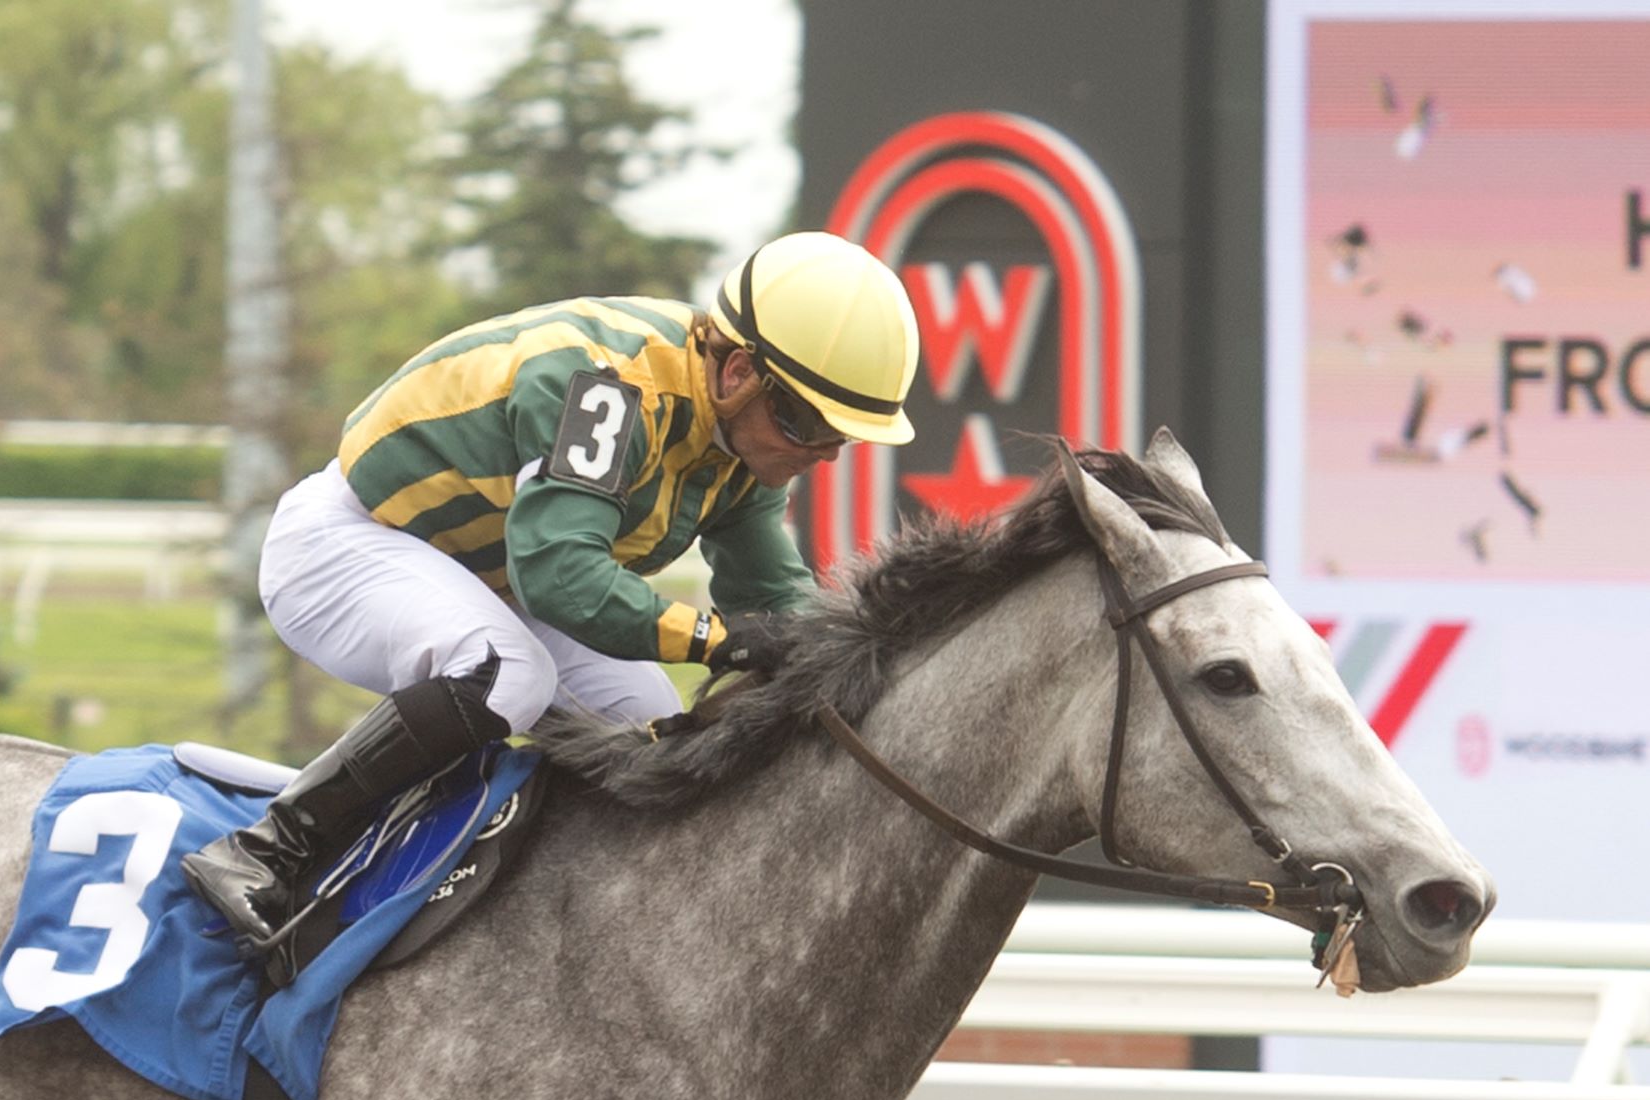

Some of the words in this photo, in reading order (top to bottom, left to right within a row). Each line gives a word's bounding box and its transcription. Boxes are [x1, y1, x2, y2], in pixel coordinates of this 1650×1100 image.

[901, 262, 1049, 402] W
[567, 383, 627, 480] 3
[2, 790, 183, 1012] 3
